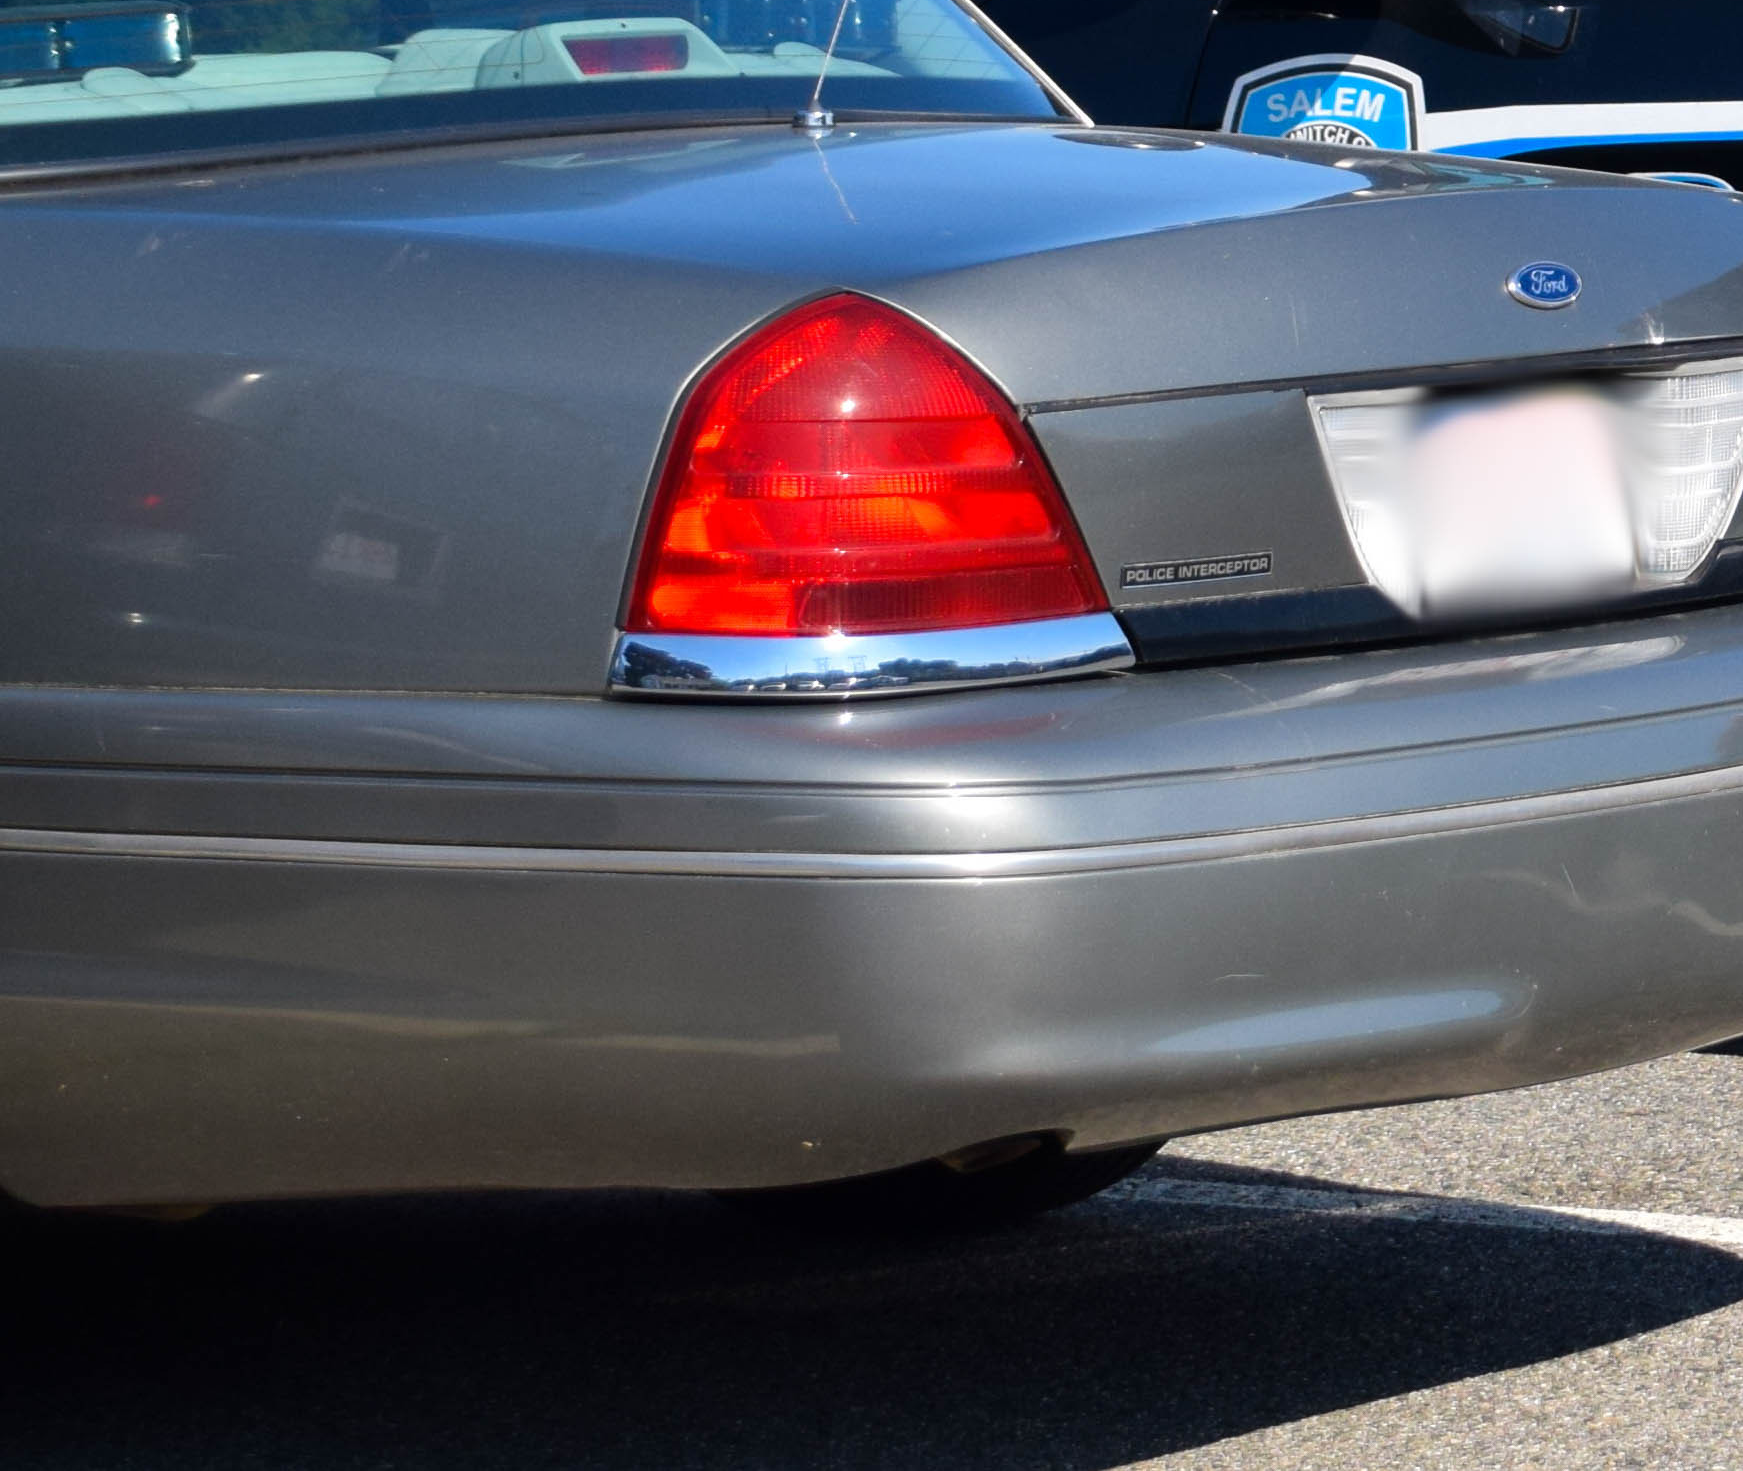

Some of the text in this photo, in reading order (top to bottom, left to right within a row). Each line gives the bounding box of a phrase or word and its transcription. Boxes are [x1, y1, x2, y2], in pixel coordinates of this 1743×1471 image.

[1266, 87, 1385, 124] SALEM
[1530, 269, 1569, 295] Ford
[1126, 556, 1269, 583] POLICE INTERCEPTOR
